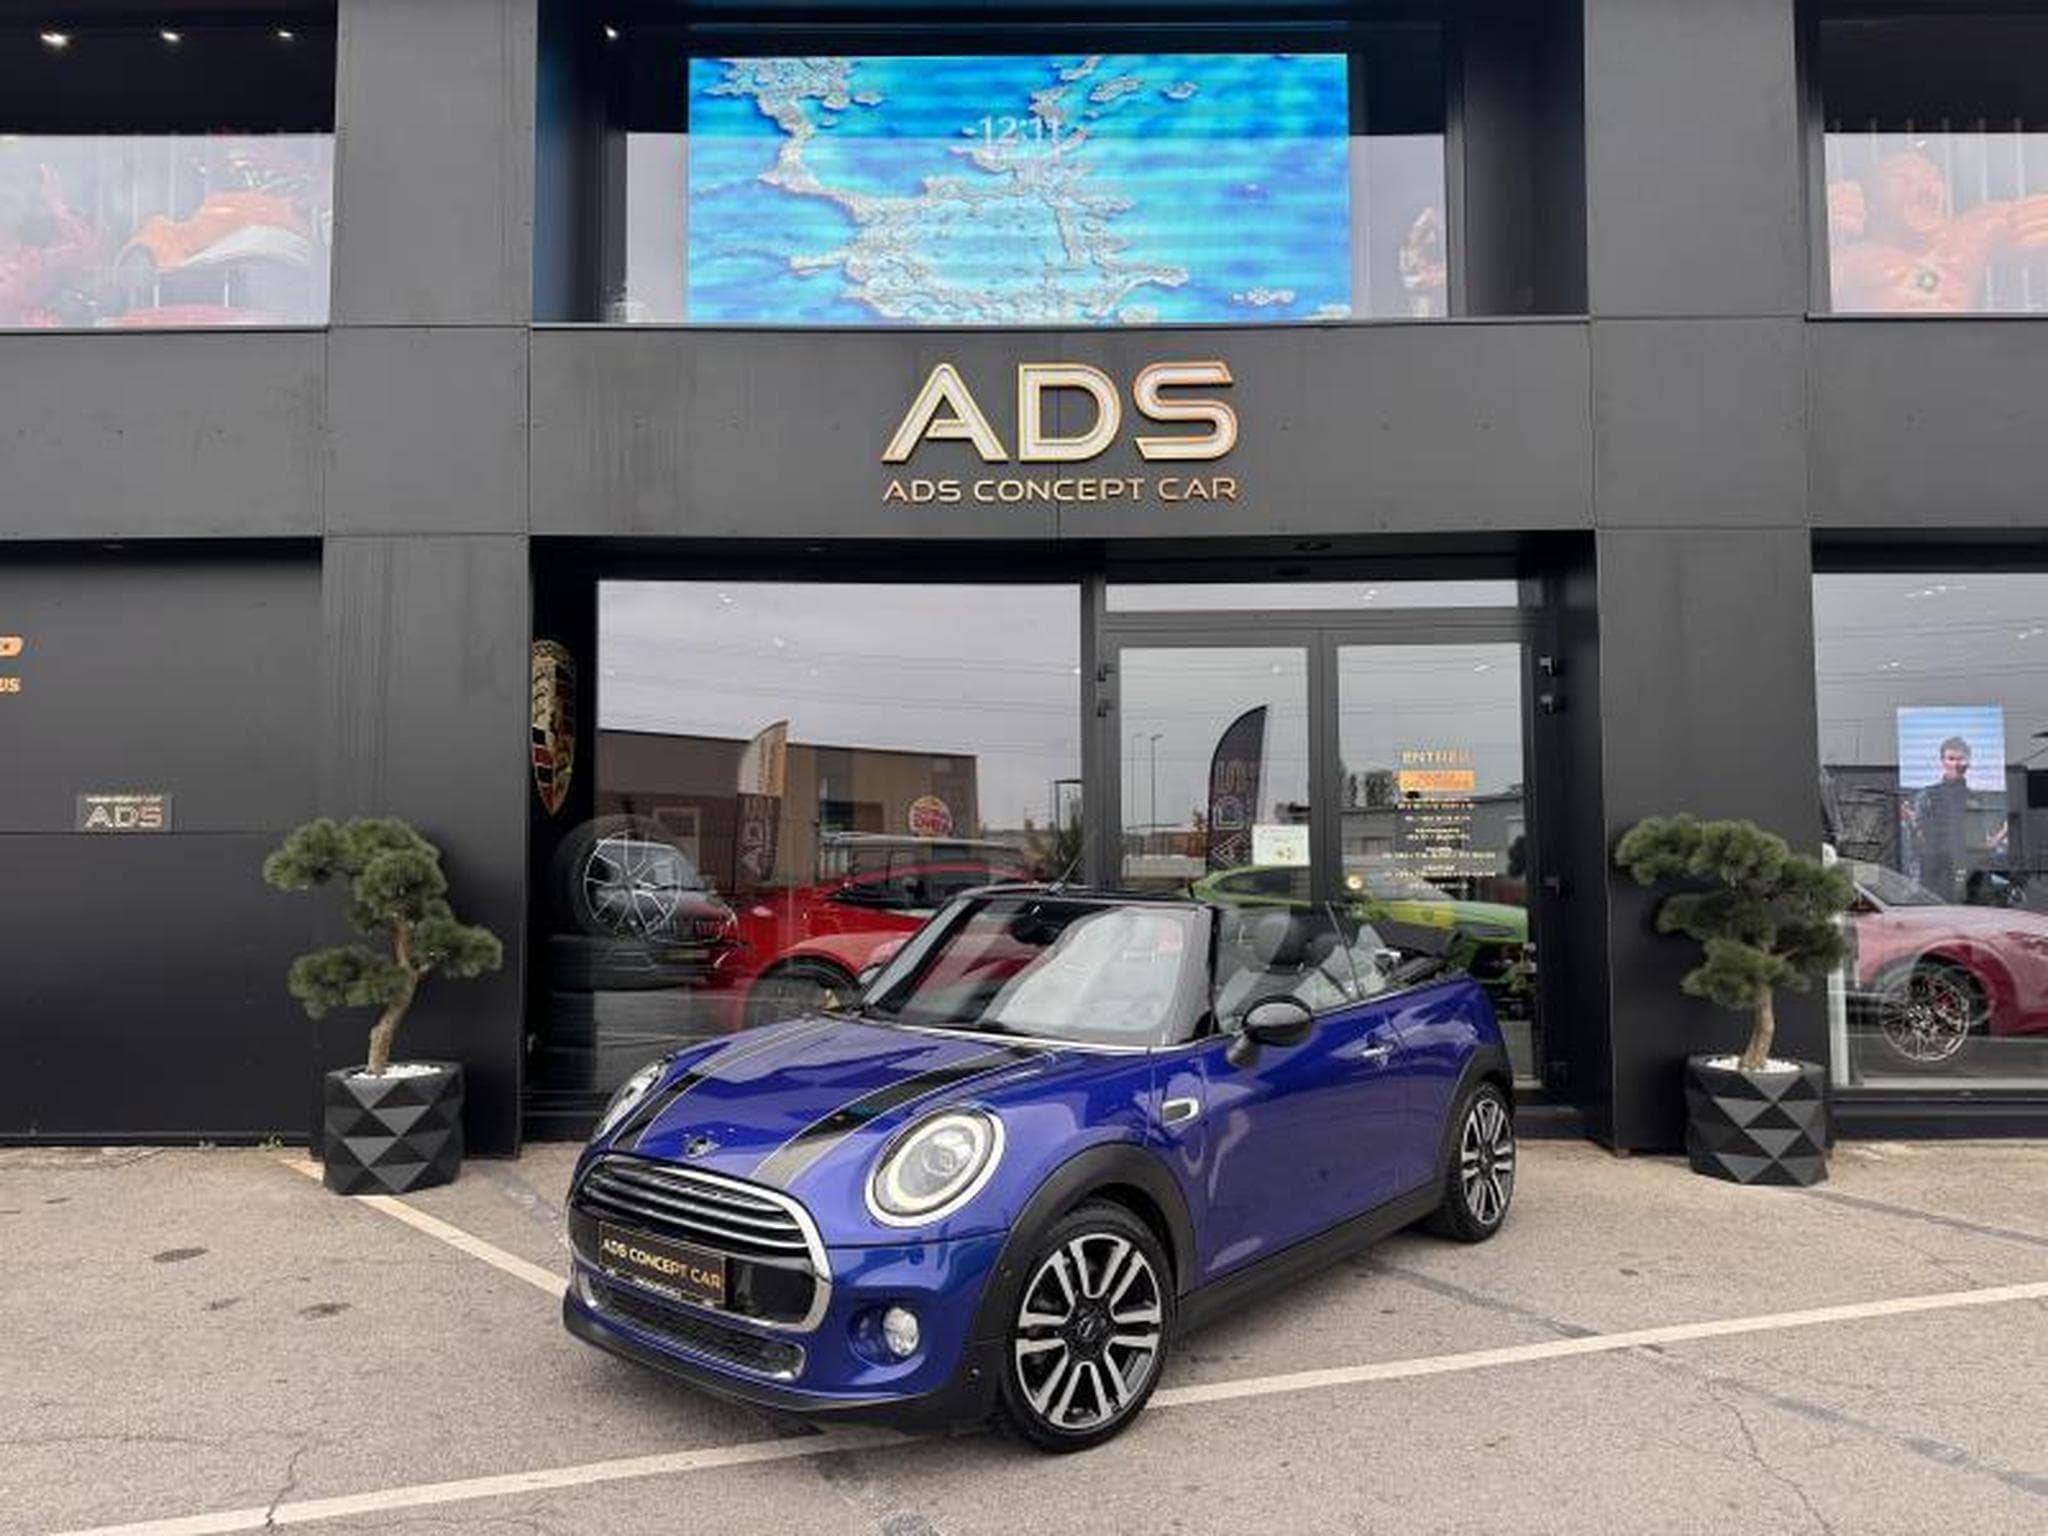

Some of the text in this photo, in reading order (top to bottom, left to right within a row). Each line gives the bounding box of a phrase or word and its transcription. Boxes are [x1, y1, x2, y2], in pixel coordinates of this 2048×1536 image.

[978, 115, 1060, 145] 12:11
[880, 361, 1239, 463] ADS
[883, 477, 1239, 503] ADS CONCEPT CAR
[84, 805, 162, 829] ADS
[629, 1247, 688, 1277] CONCEPT
[690, 1267, 721, 1289] CAR
